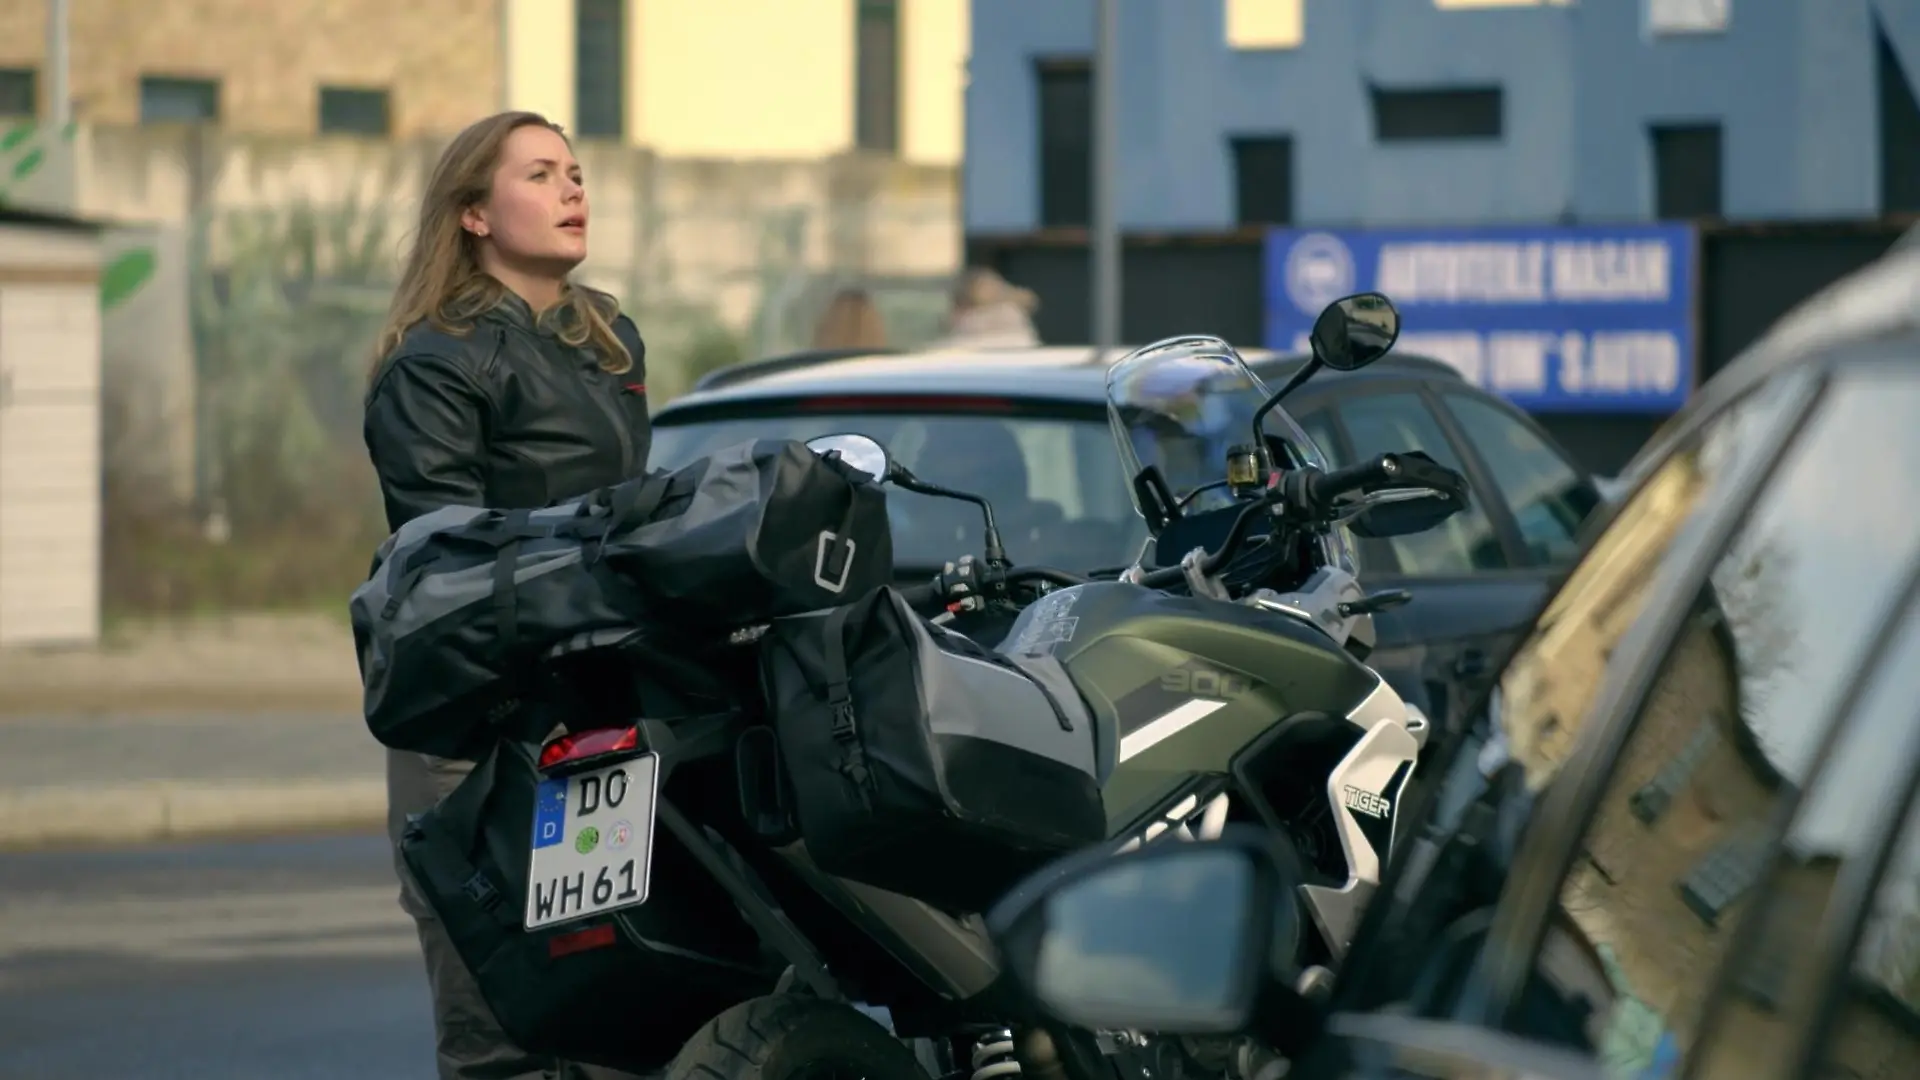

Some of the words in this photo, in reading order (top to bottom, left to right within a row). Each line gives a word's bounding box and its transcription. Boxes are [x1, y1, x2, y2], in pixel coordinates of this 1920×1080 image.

[577, 768, 628, 817] DO
[1343, 784, 1391, 818] TIGER
[543, 822, 557, 839] D
